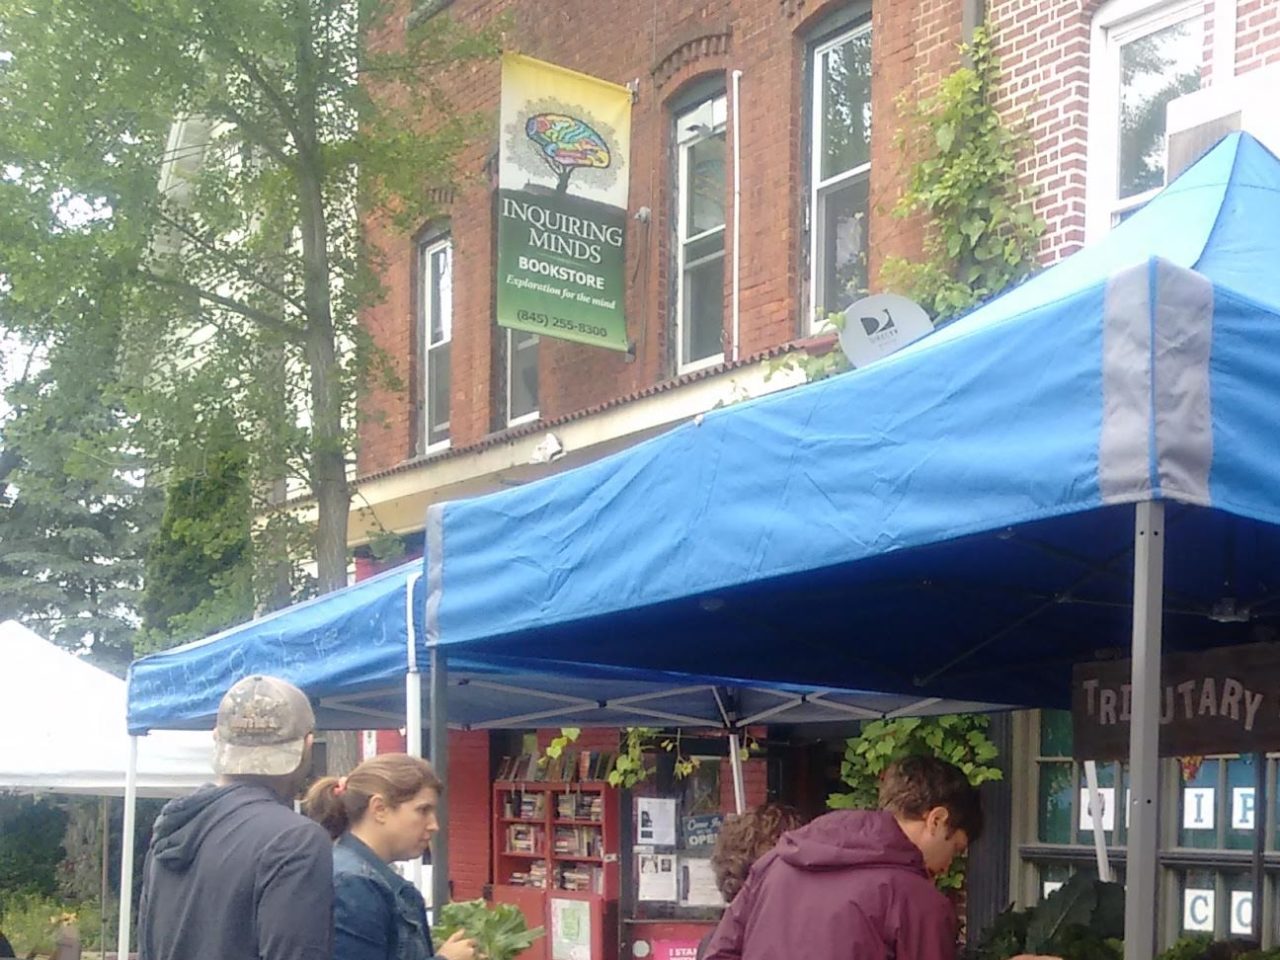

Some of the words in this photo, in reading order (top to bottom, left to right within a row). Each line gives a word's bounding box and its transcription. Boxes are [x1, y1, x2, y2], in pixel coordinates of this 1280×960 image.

[503, 198, 623, 247] INQUIRING
[528, 227, 602, 264] MINDS
[506, 273, 561, 295] Exploration
[560, 288, 576, 300] for
[577, 293, 591, 304] the
[592, 299, 616, 310] mind
[518, 256, 605, 290] BOOKSTORE
[517, 309, 549, 328] (845)
[1083, 678, 1264, 731] TRIUTARY
